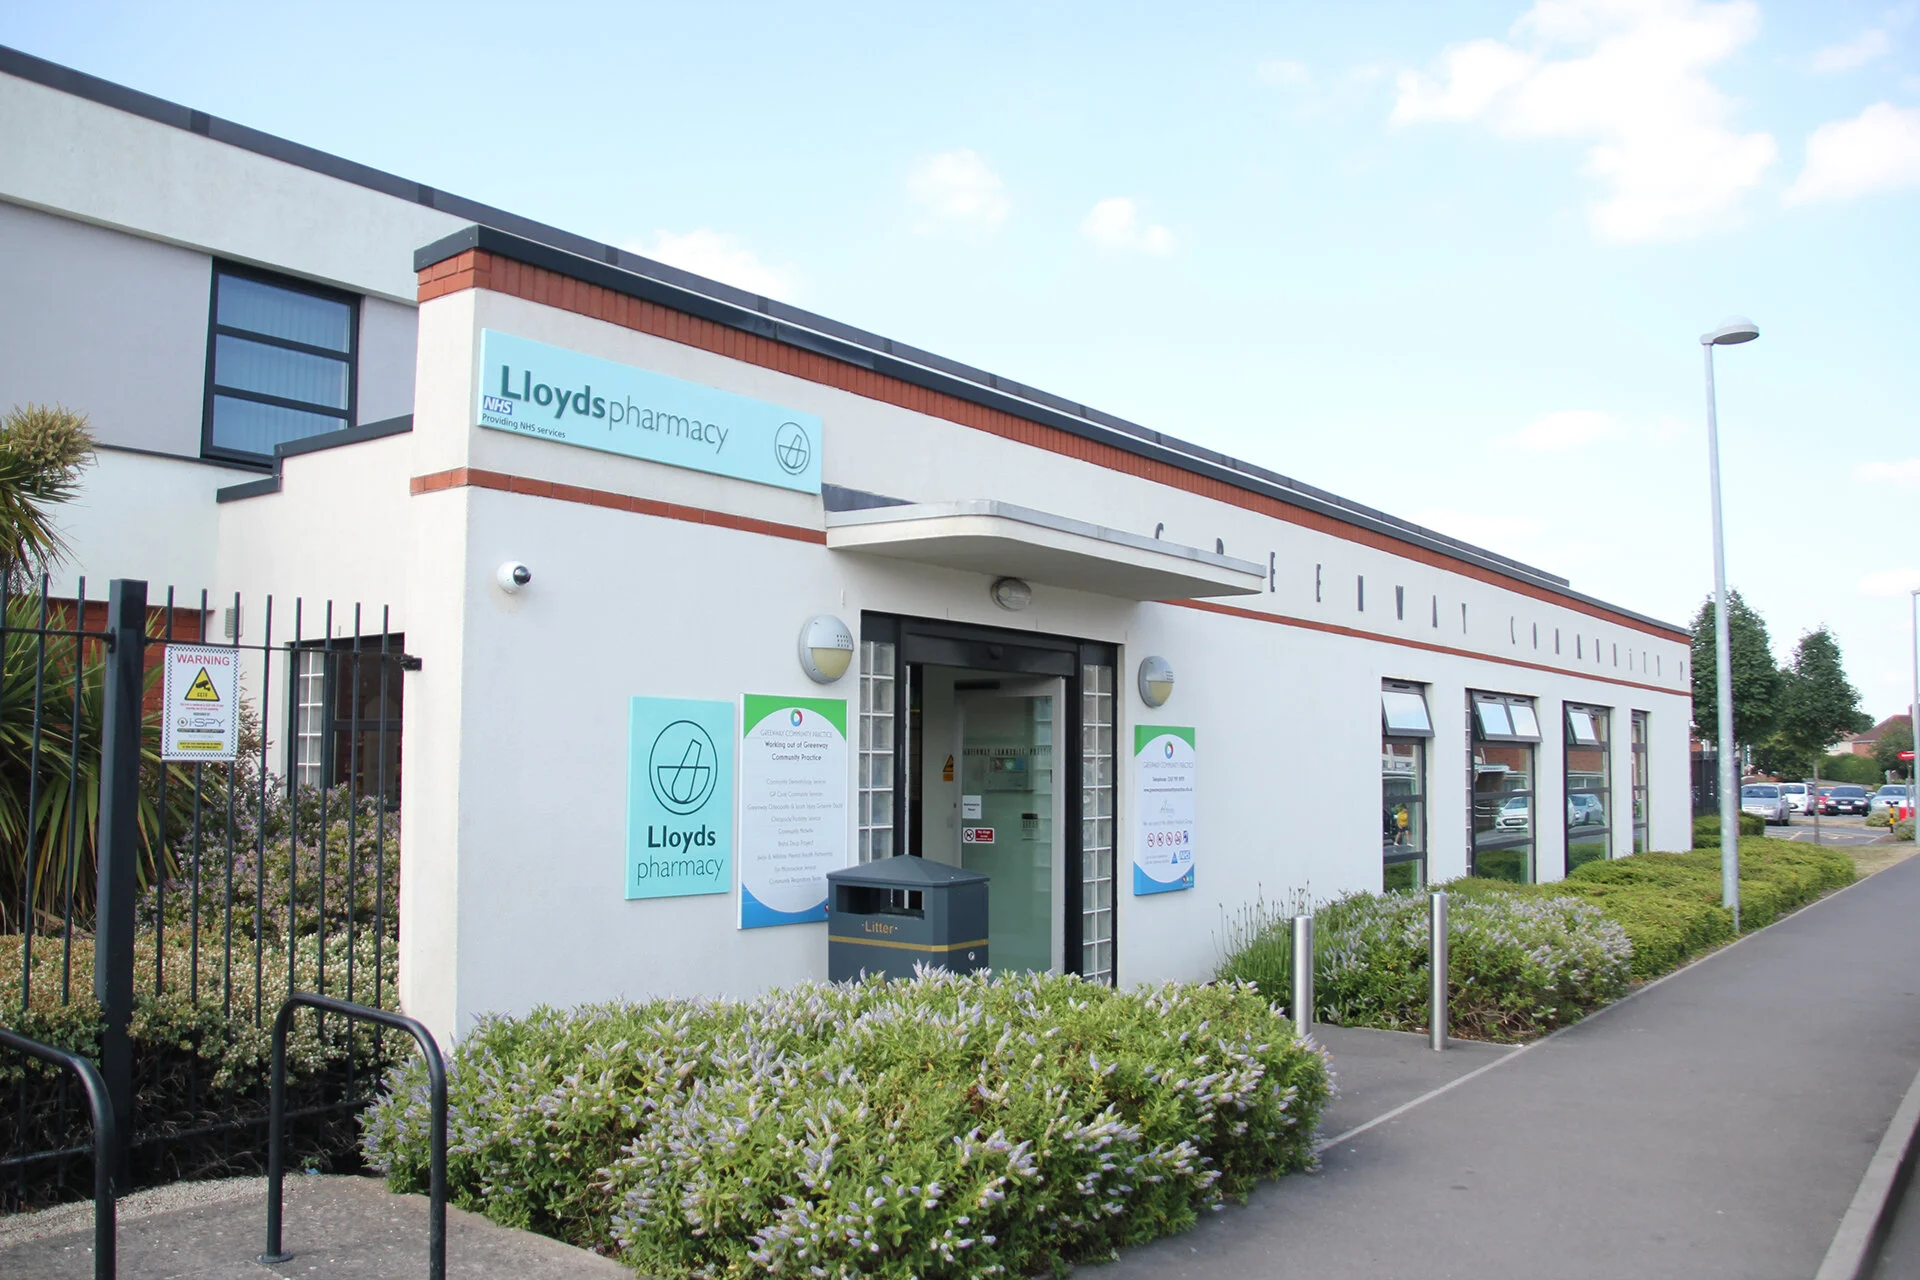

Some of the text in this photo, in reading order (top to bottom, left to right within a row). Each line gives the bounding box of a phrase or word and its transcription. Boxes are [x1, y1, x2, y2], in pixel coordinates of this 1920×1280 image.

[483, 396, 512, 414] NHS
[482, 413, 566, 438] Providing NHS services
[176, 653, 230, 666] WARNING
[765, 741, 786, 750] Working
[787, 741, 795, 749] out
[803, 741, 828, 750] Greenway
[771, 753, 822, 762] Community Practice
[647, 824, 716, 854] Lloyds
[636, 854, 724, 886] pharmacy
[864, 919, 894, 935] Litter
